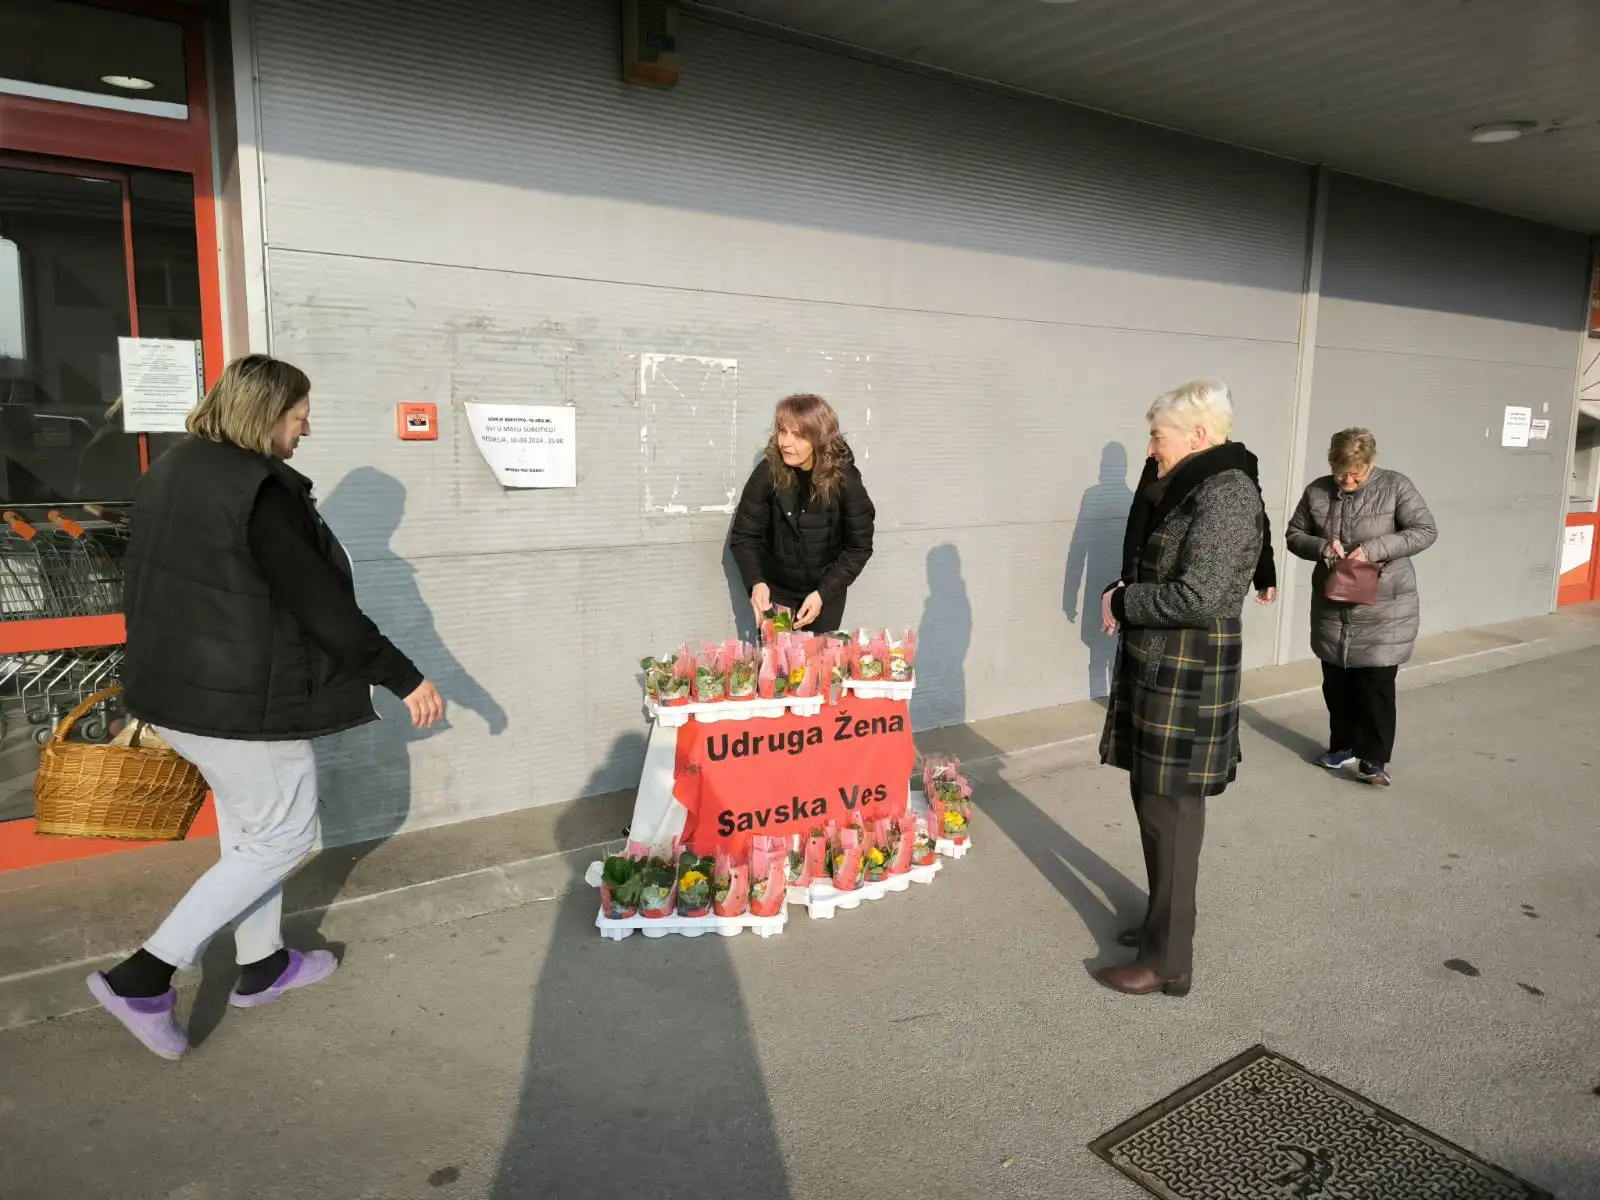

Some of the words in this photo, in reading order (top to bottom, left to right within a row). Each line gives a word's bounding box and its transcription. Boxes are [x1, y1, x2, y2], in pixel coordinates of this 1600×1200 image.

[707, 726, 823, 761] Udruga
[833, 710, 904, 741] Žena
[717, 796, 827, 837] Savska
[838, 783, 888, 810] Ves
